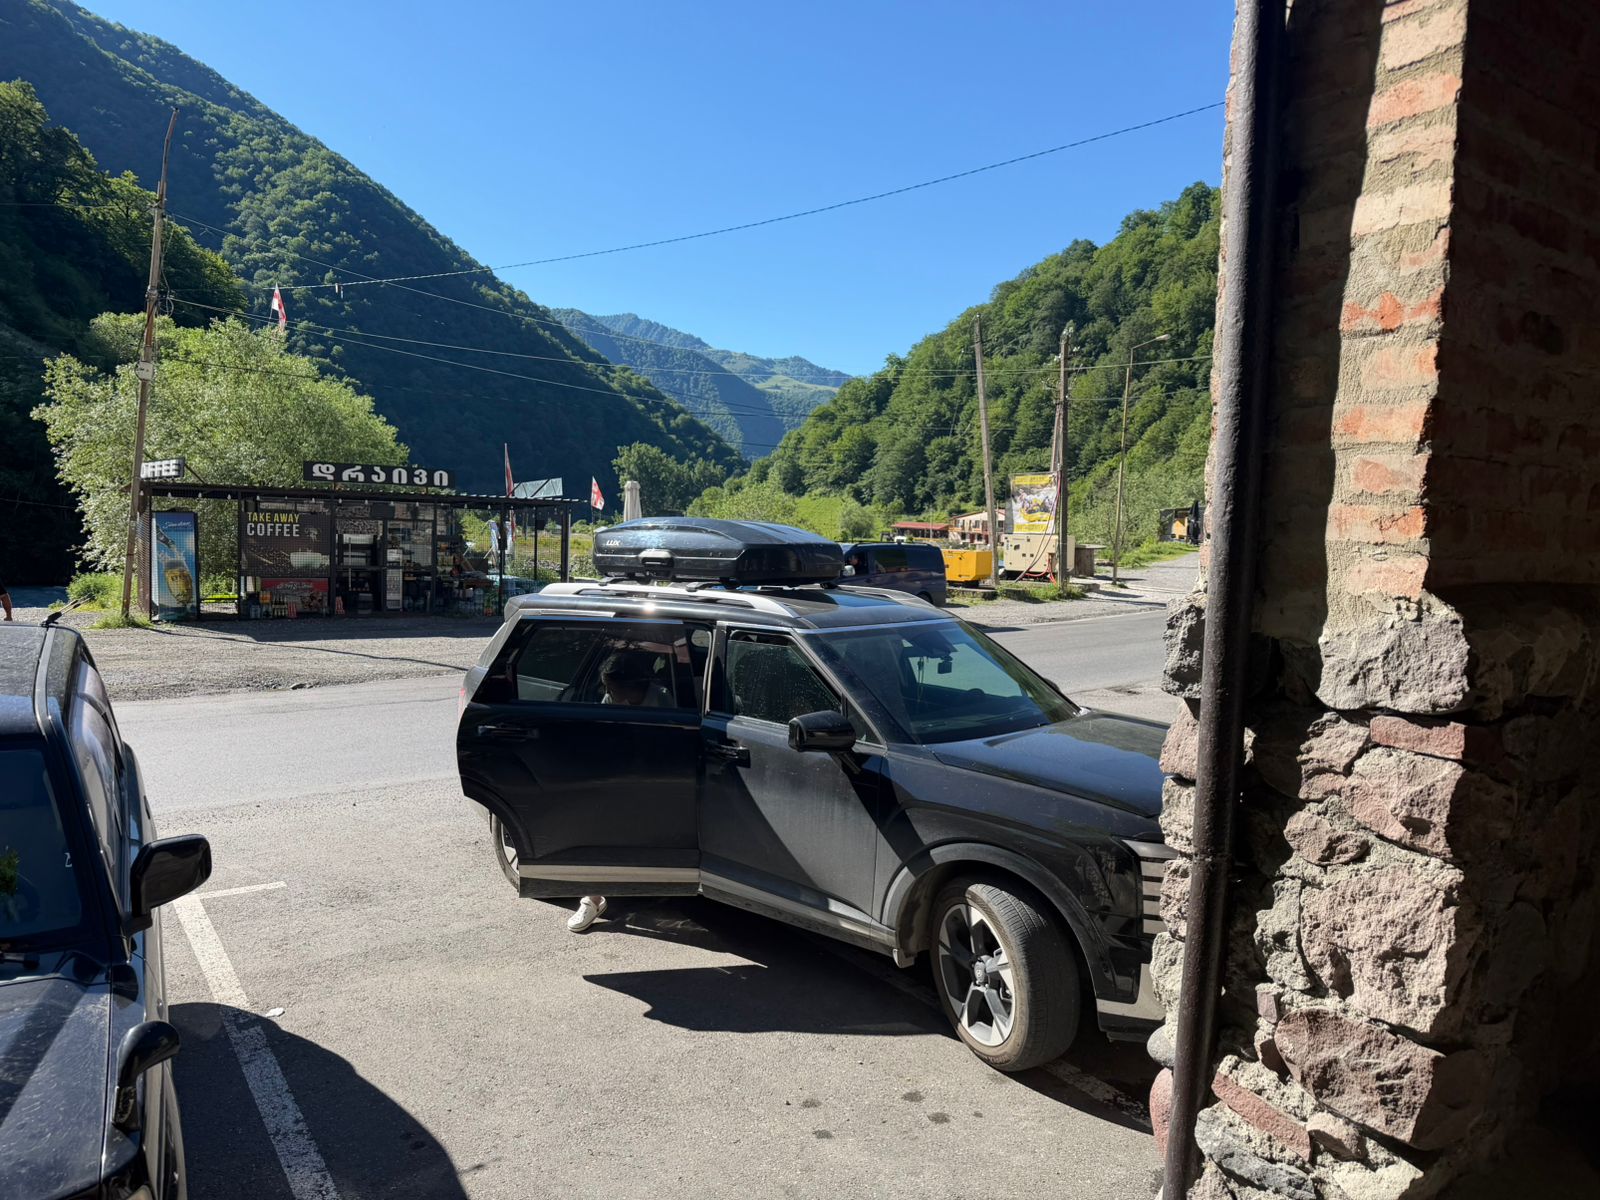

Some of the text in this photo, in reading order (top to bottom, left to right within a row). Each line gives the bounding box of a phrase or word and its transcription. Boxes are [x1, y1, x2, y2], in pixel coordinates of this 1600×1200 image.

[140, 460, 179, 478] OFFEE
[312, 463, 449, 486] დრაივი
[247, 511, 300, 523] TAKE AWAY
[246, 523, 300, 537] COFFEE
